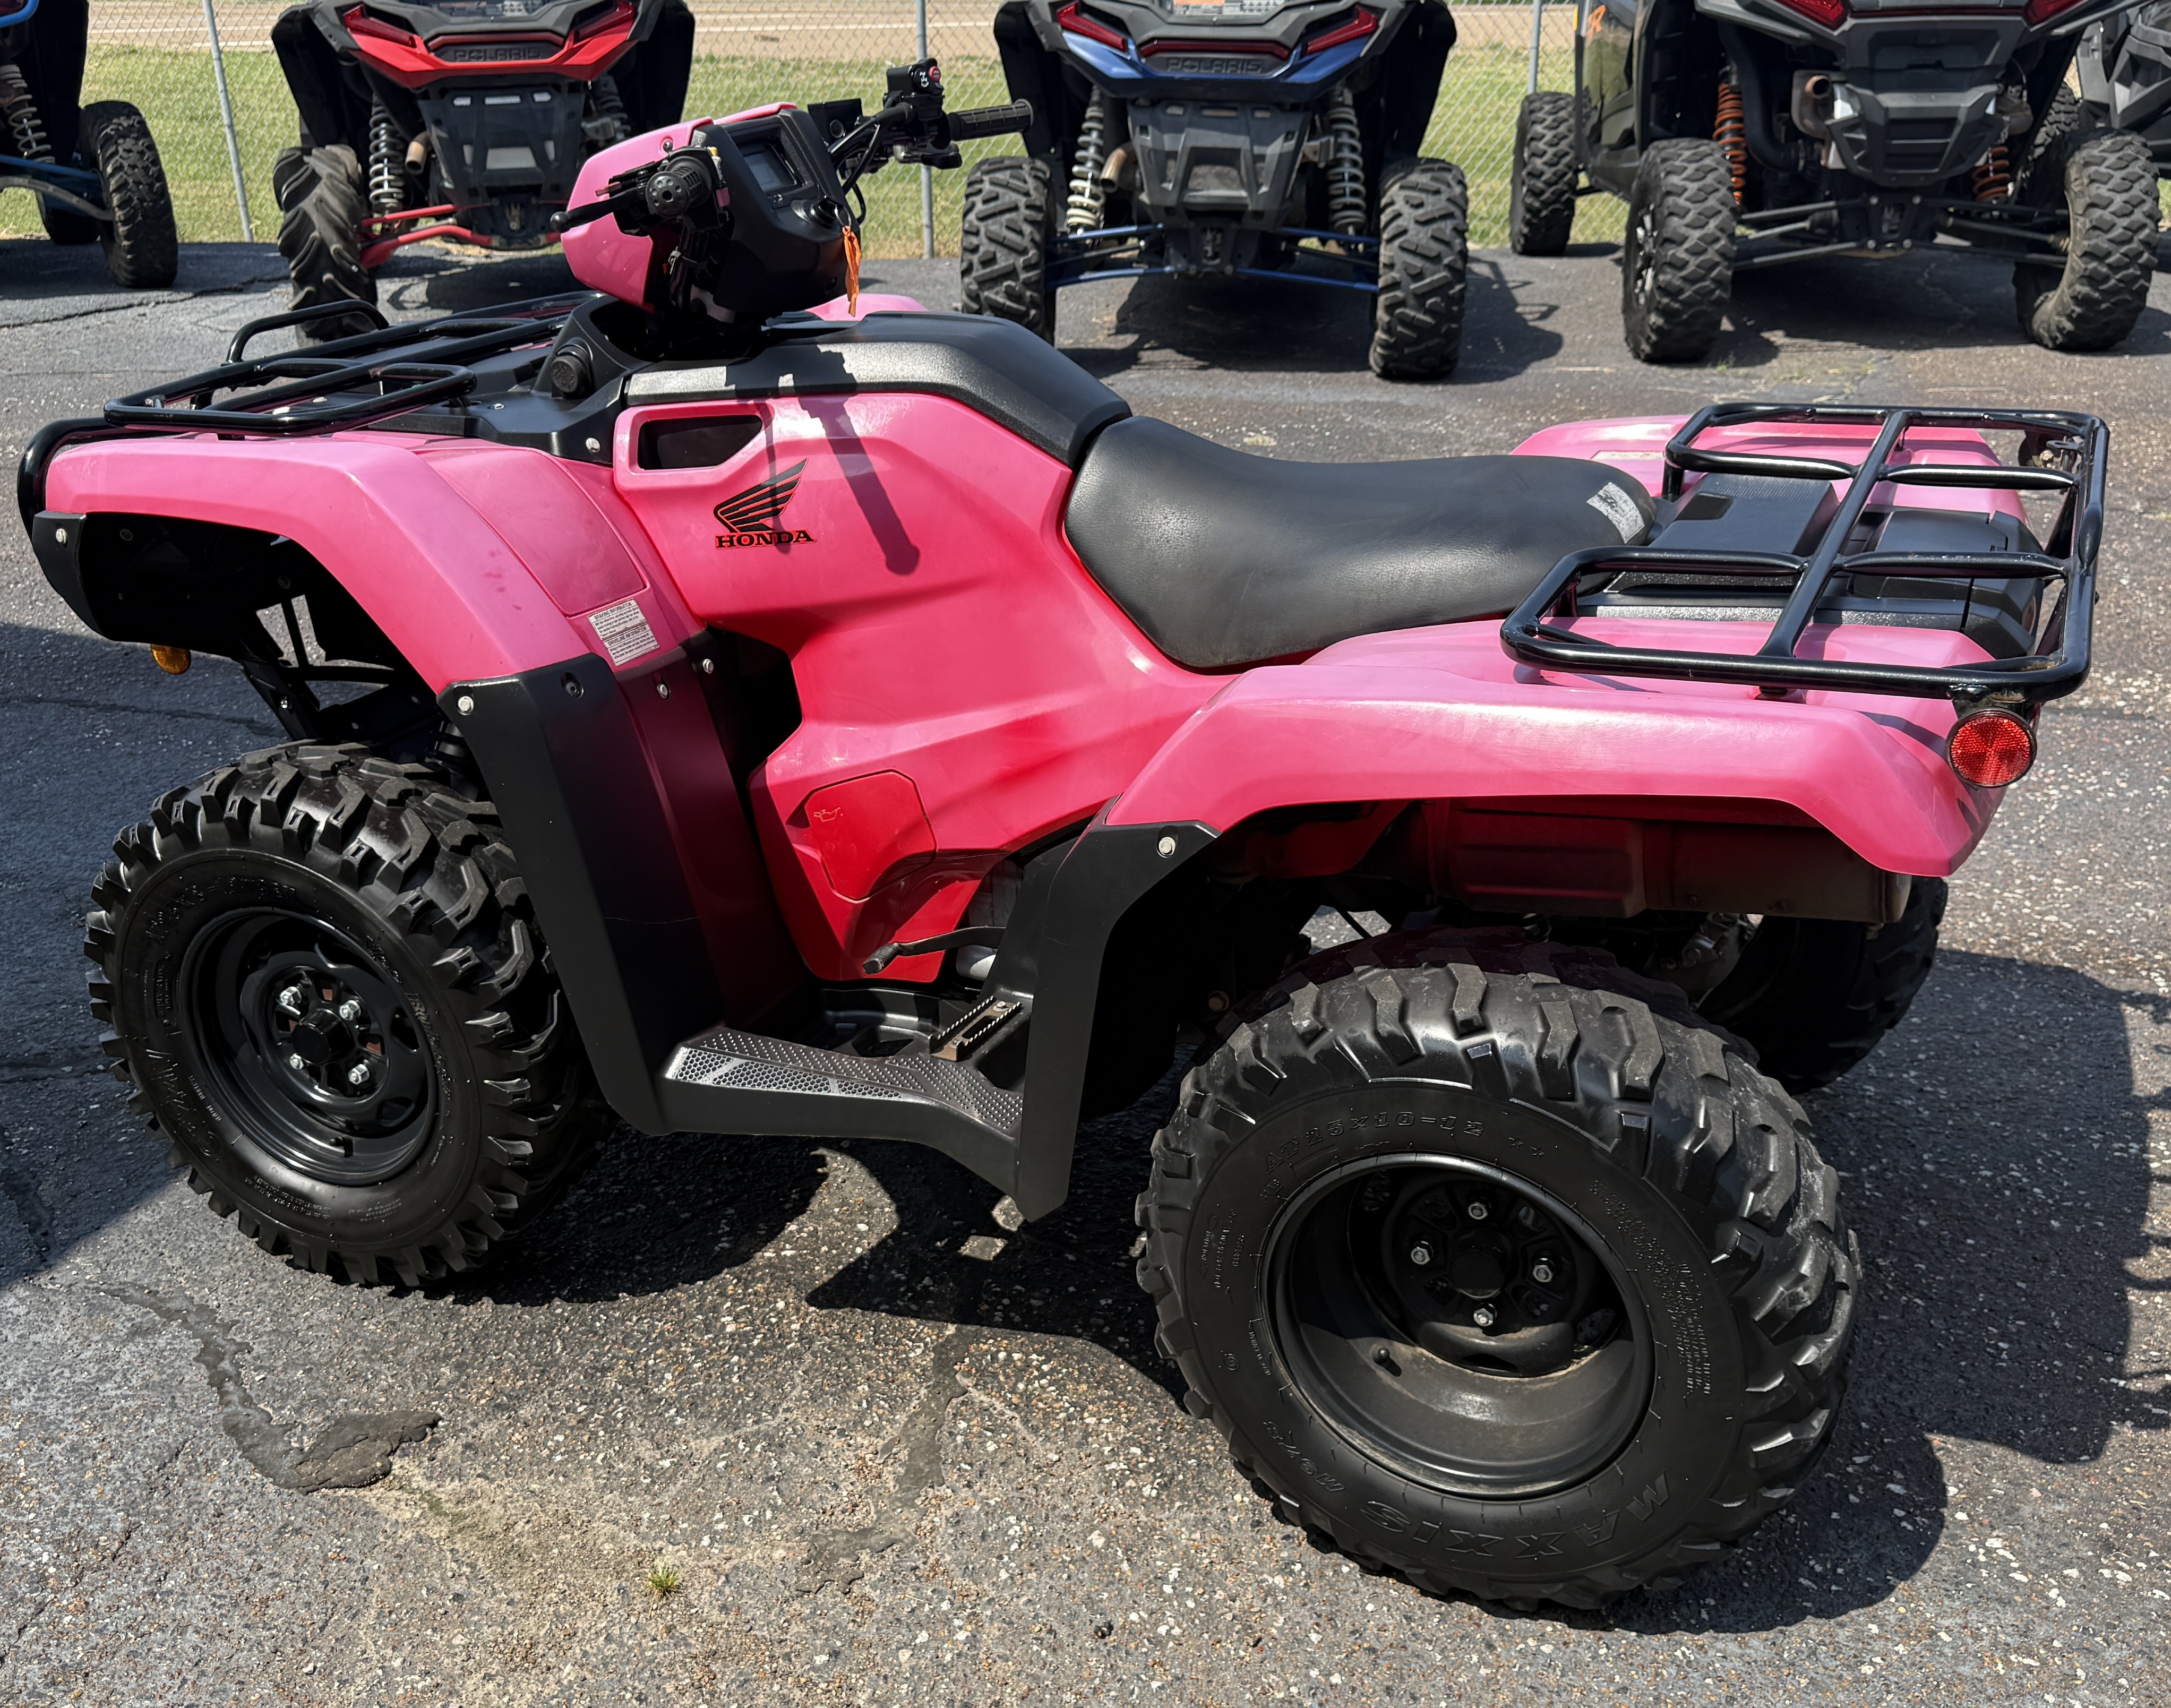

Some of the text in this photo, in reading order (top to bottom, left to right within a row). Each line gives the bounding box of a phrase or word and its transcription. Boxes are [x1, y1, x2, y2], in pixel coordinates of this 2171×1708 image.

[455, 48, 540, 62] POLARIS
[1168, 58, 1264, 73] POLARIS
[715, 530, 815, 548] HONDA
[610, 603, 632, 614] INFORMATION
[625, 627, 647, 638] INFORMATION
[1359, 1469, 1671, 1560] MAXXIS
